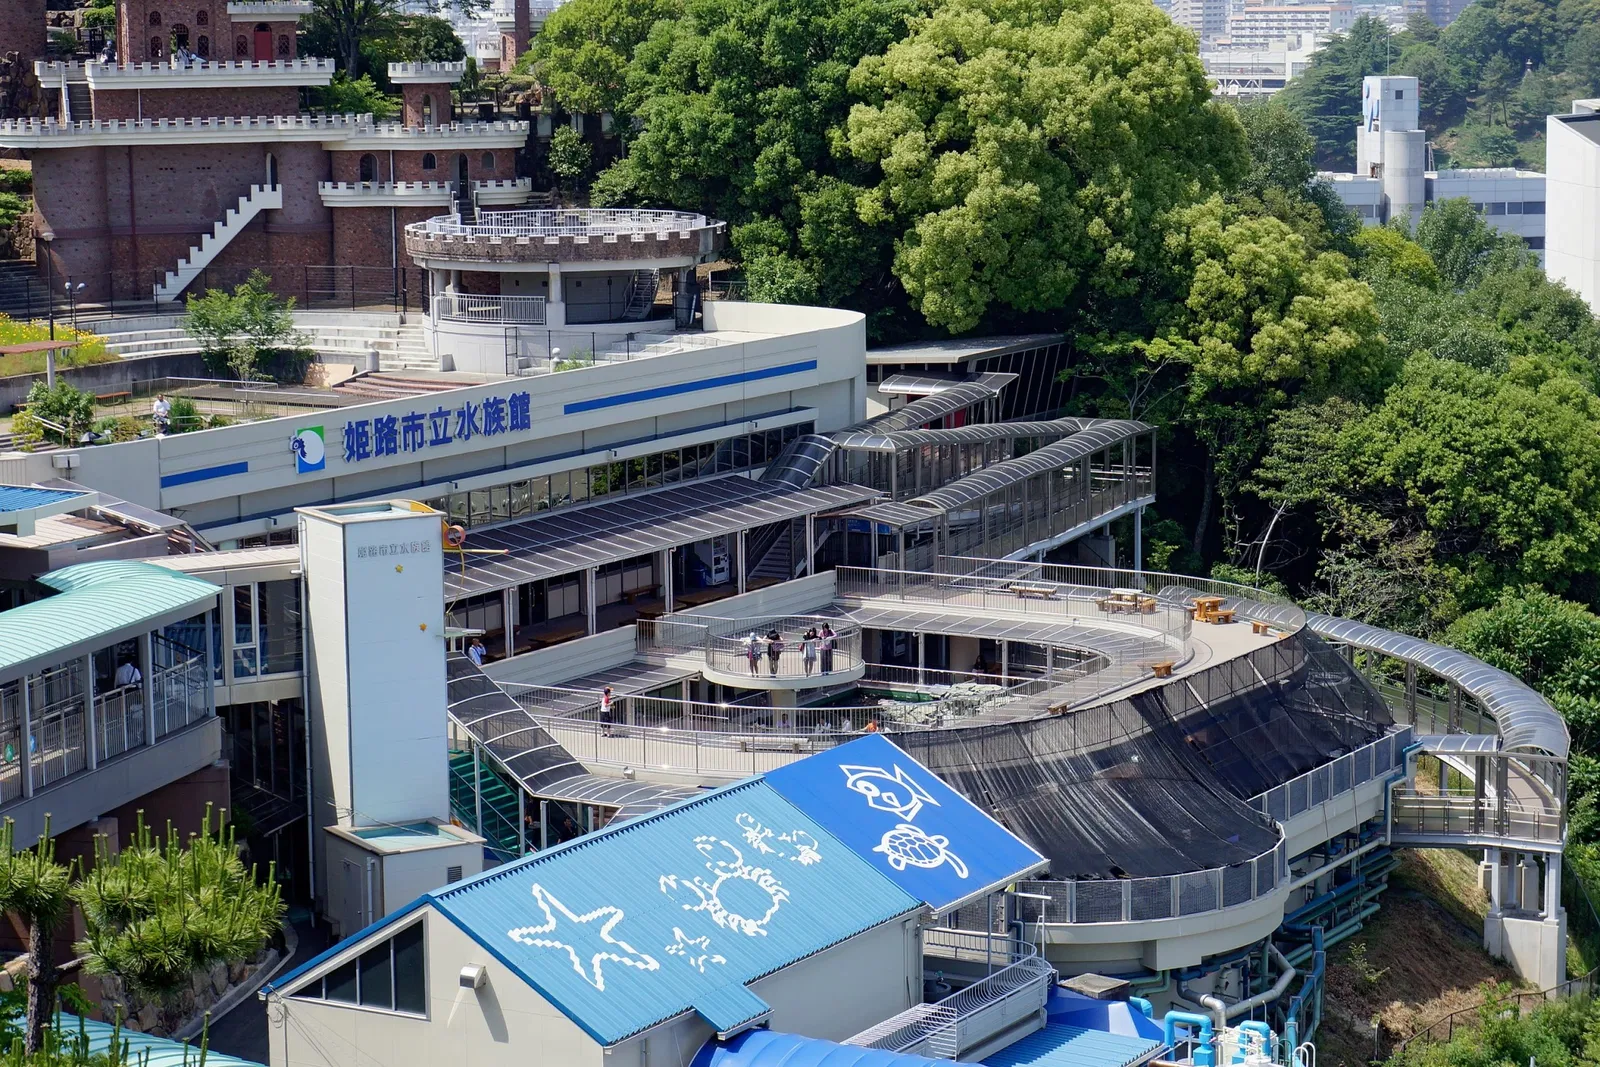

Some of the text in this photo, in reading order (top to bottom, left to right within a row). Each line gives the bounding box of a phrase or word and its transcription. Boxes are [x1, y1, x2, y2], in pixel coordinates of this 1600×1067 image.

[343, 391, 531, 463] 姫路市立水族館
